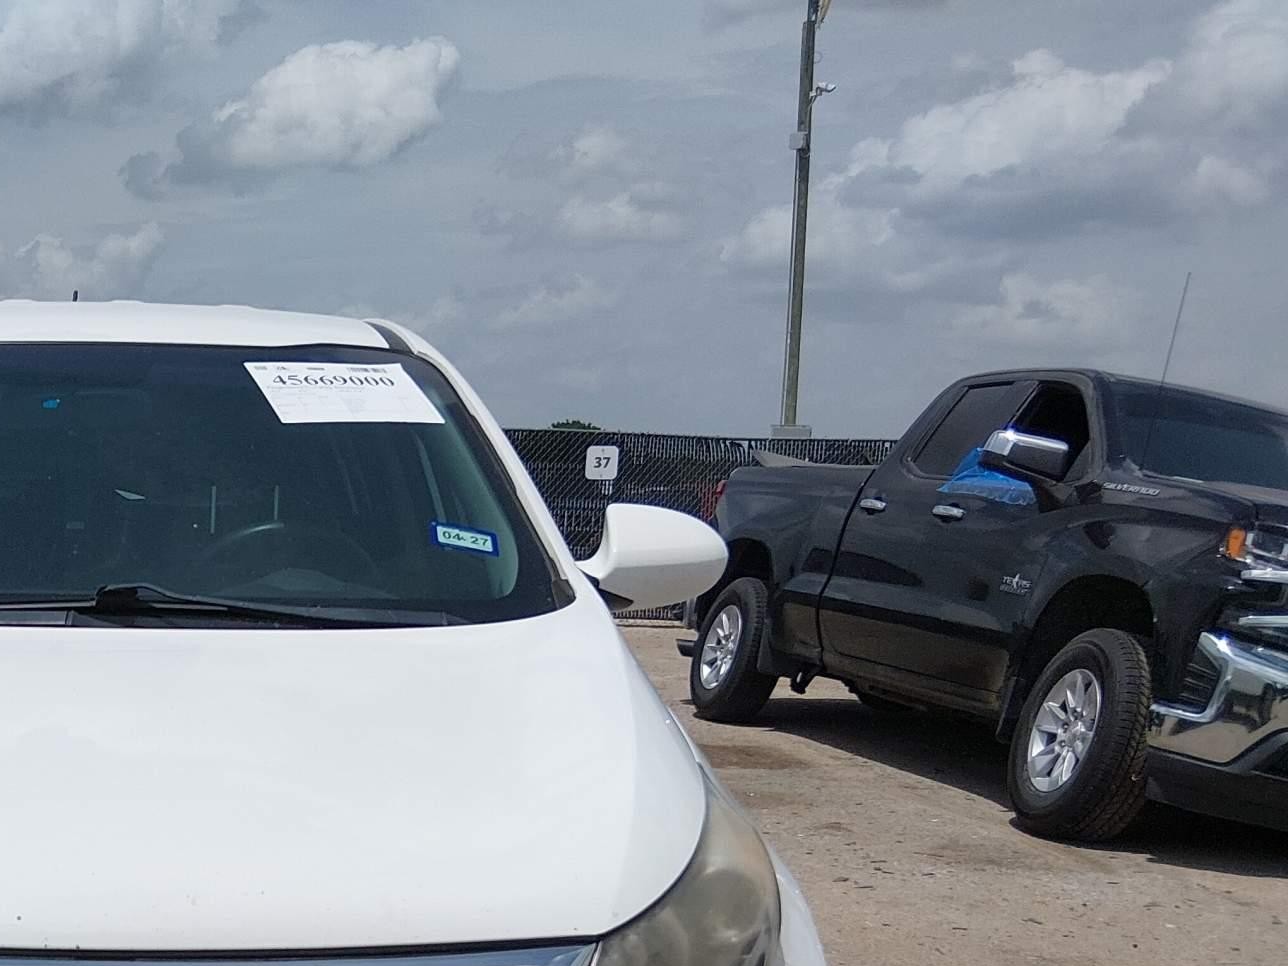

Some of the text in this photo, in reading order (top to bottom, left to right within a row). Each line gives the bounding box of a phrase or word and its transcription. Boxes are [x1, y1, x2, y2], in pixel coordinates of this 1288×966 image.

[272, 374, 395, 387] 45669000
[593, 456, 611, 469] 37
[469, 535, 489, 546] 27
